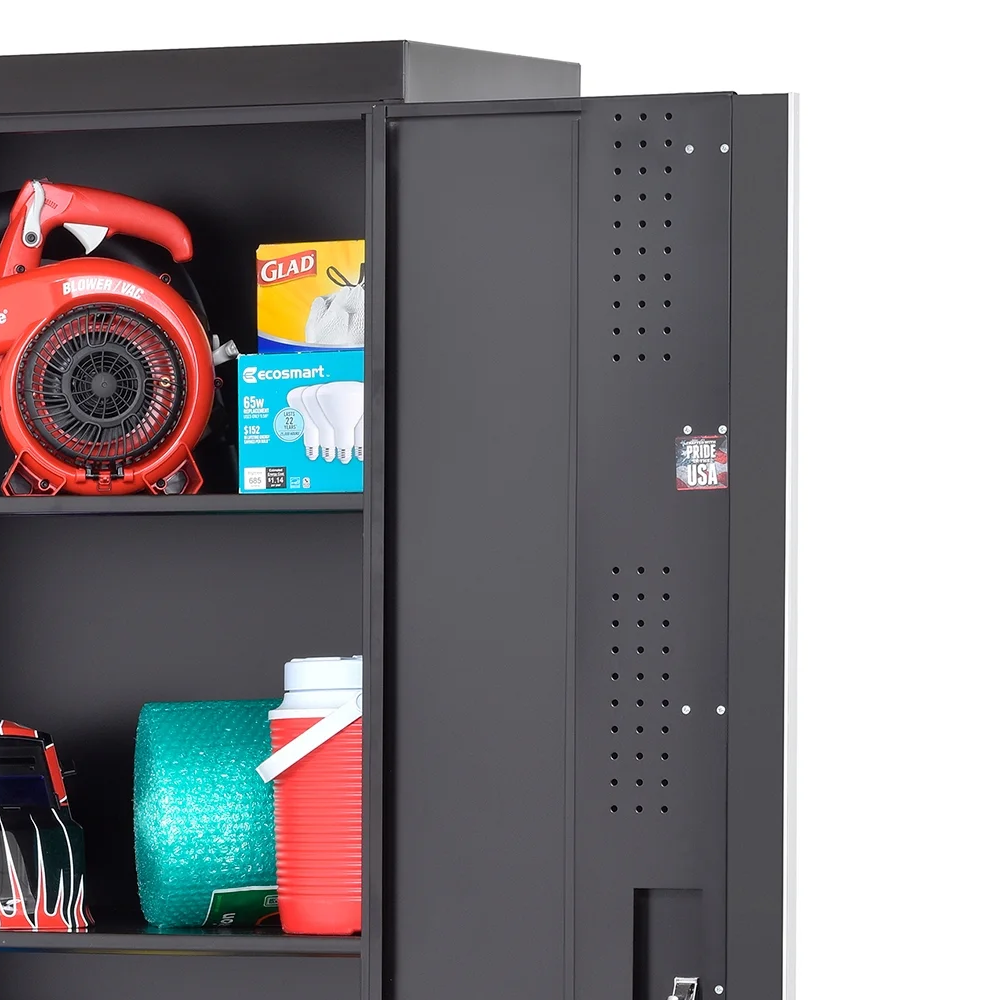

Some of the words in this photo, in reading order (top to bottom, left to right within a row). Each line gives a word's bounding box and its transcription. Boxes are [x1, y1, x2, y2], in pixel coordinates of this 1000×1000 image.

[261, 254, 315, 282] GLAD
[257, 365, 325, 380] ecosmart
[285, 416, 294, 425] 22
[243, 425, 261, 435] $152
[686, 444, 717, 459] PRIDE
[687, 463, 718, 486] USA
